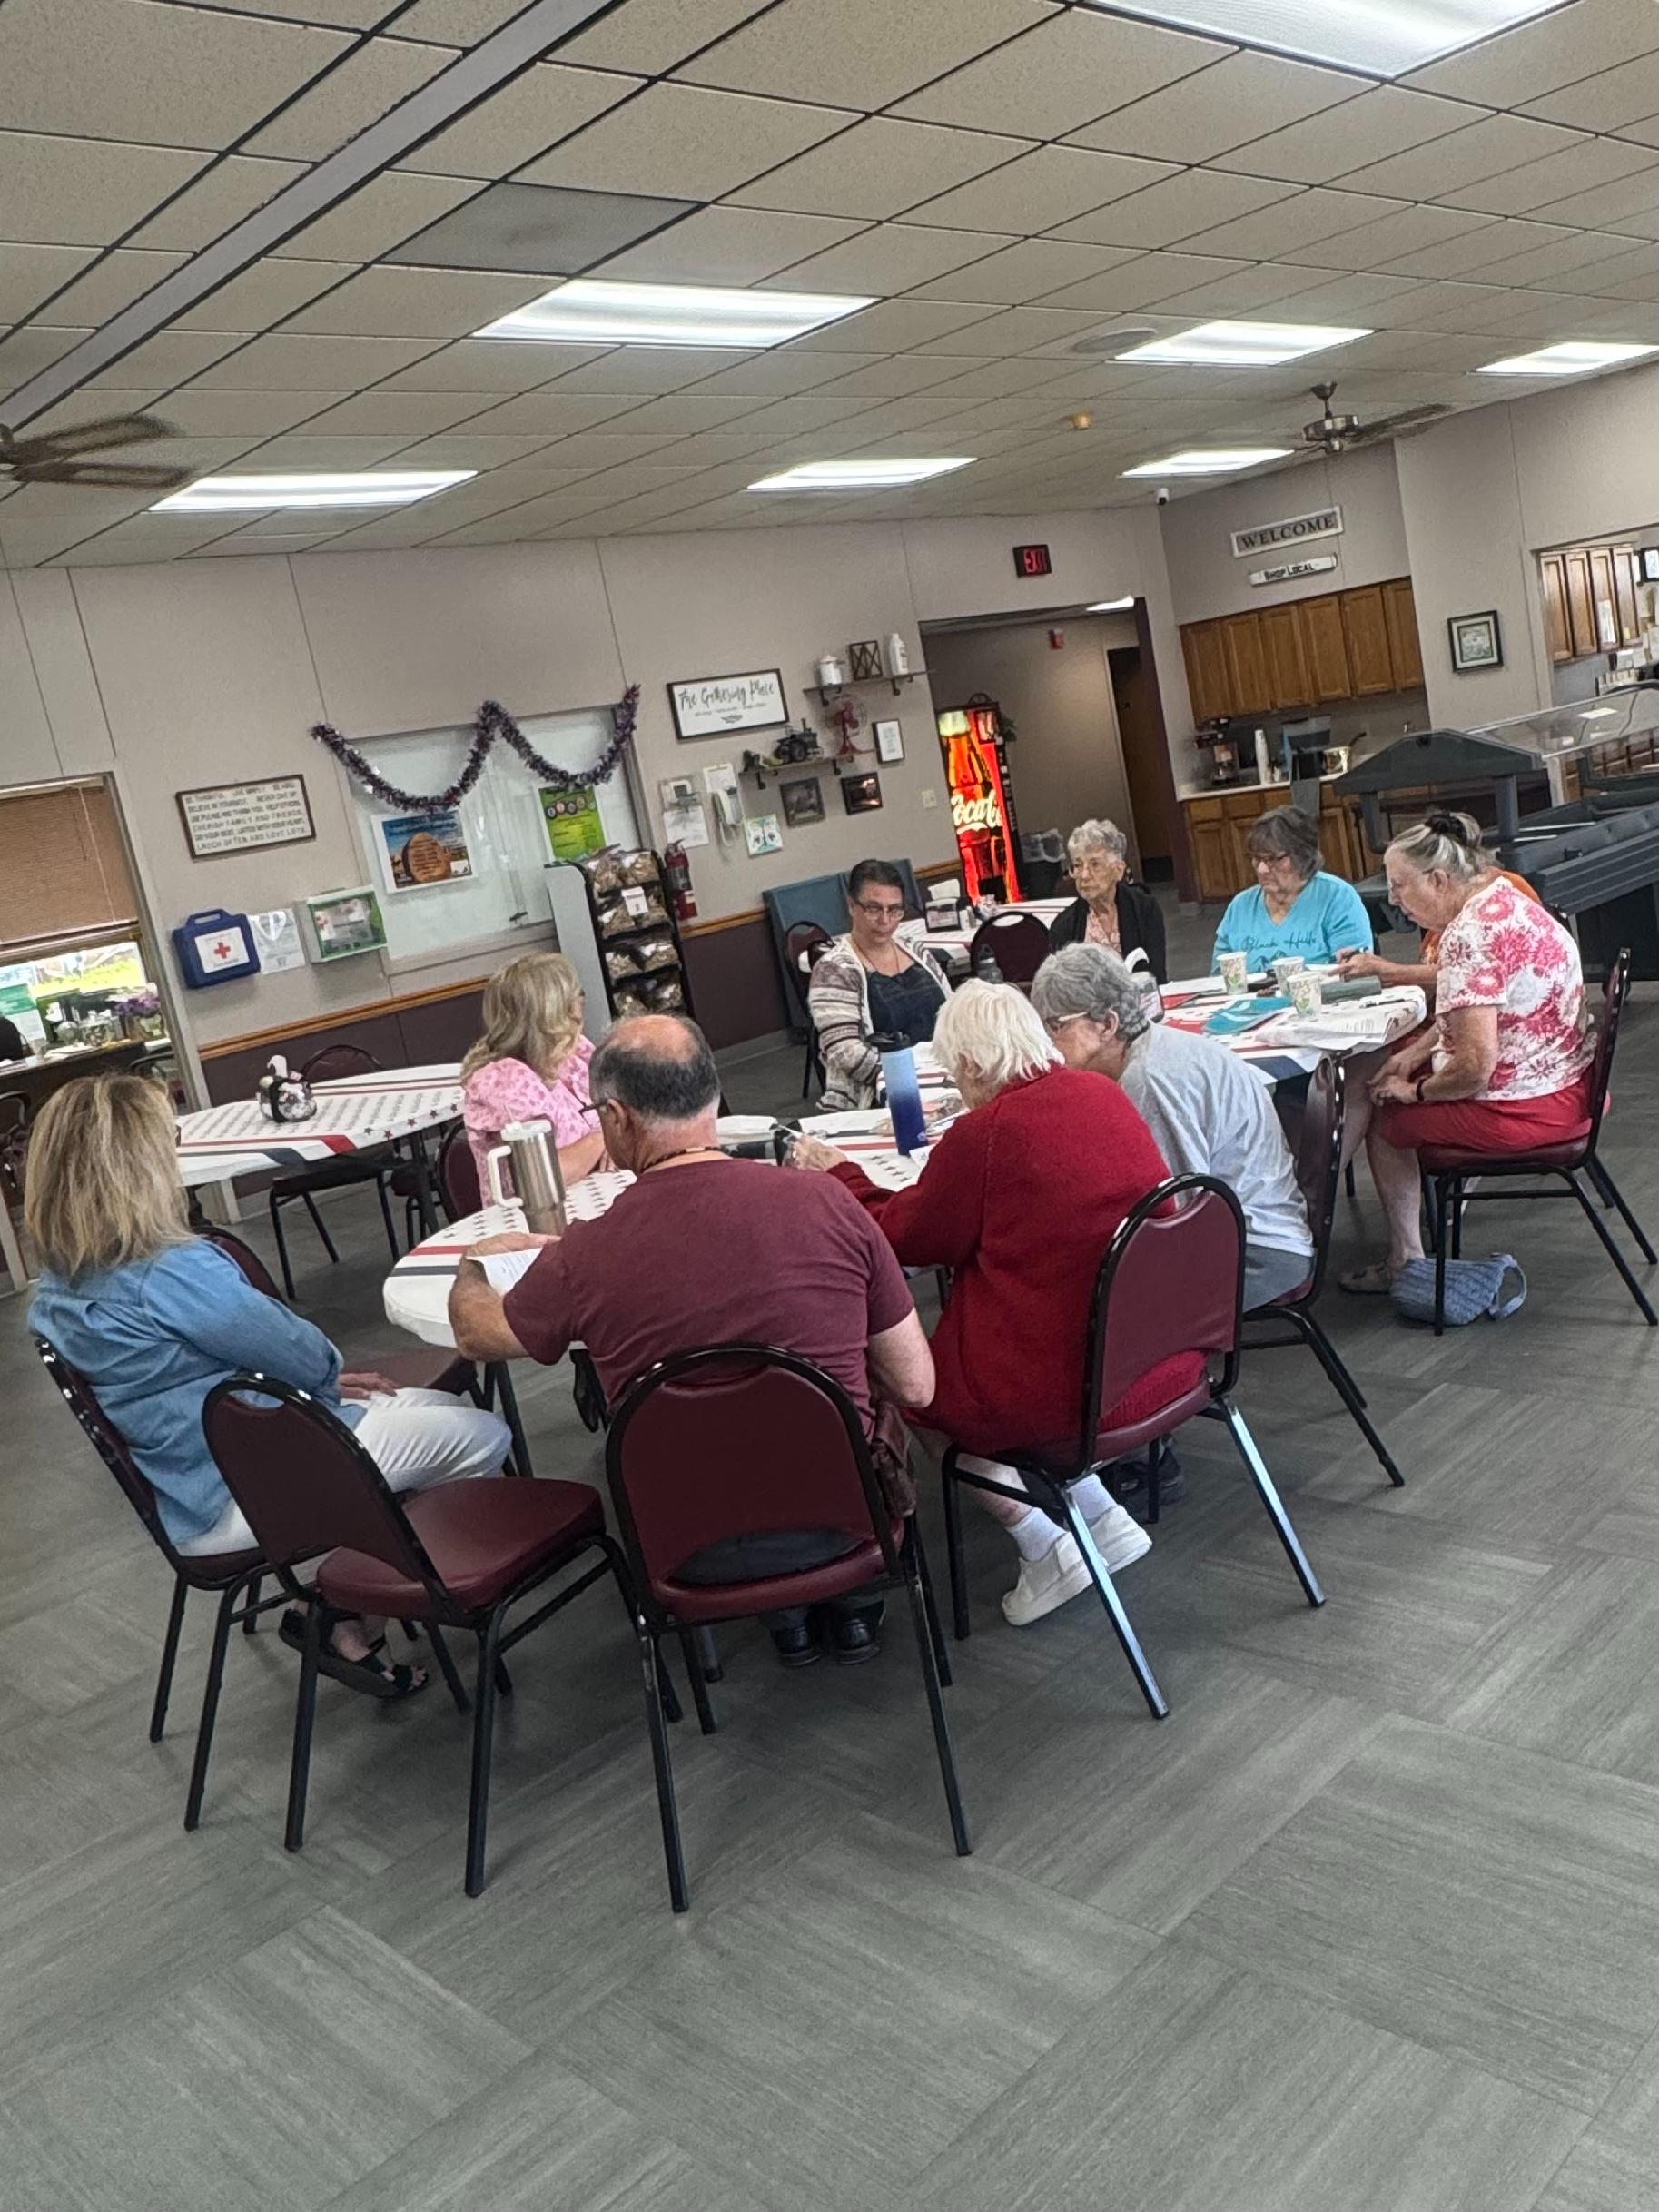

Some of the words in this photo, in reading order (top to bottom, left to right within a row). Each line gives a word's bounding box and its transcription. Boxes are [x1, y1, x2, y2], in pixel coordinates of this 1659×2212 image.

[1241, 517, 1335, 548] WELCOME
[1241, 934, 1279, 954] Black
[1283, 930, 1317, 949] Hills
